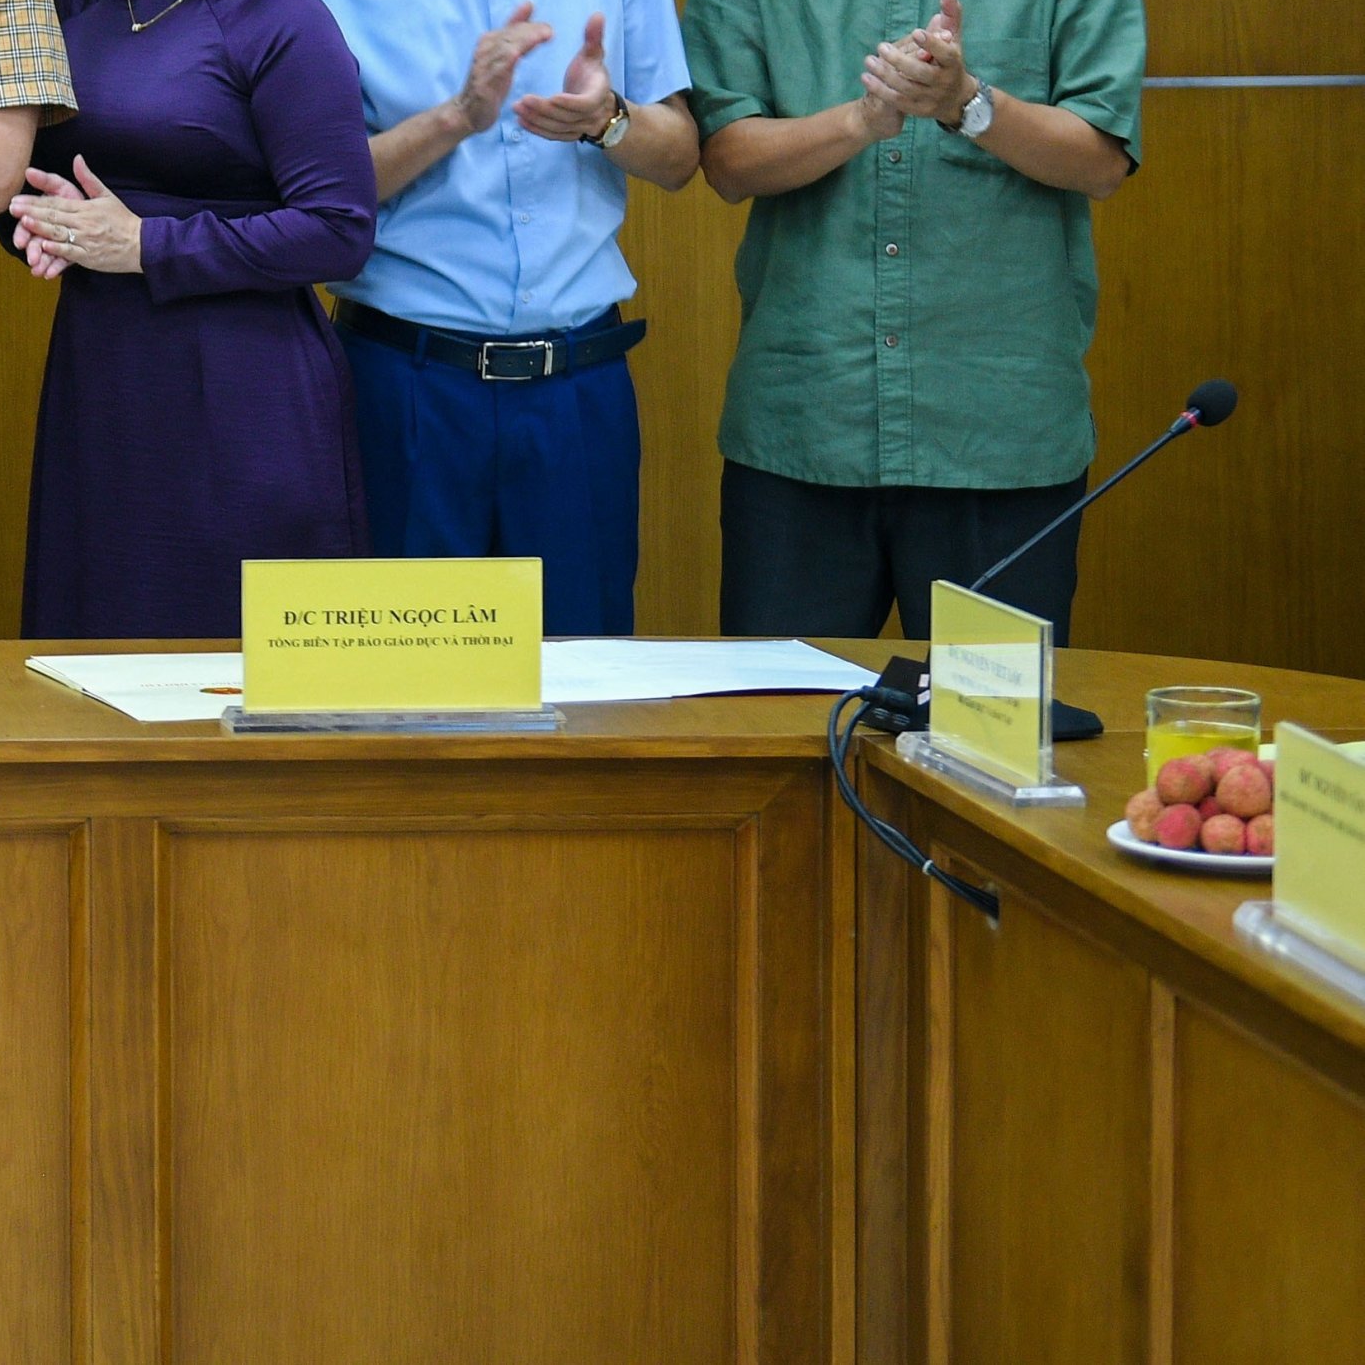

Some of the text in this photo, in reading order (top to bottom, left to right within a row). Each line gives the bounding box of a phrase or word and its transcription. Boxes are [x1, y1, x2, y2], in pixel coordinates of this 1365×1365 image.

[283, 604, 497, 628] Đ/C TRIỆU NGỌC LÂM
[383, 635, 414, 647] GIÁO
